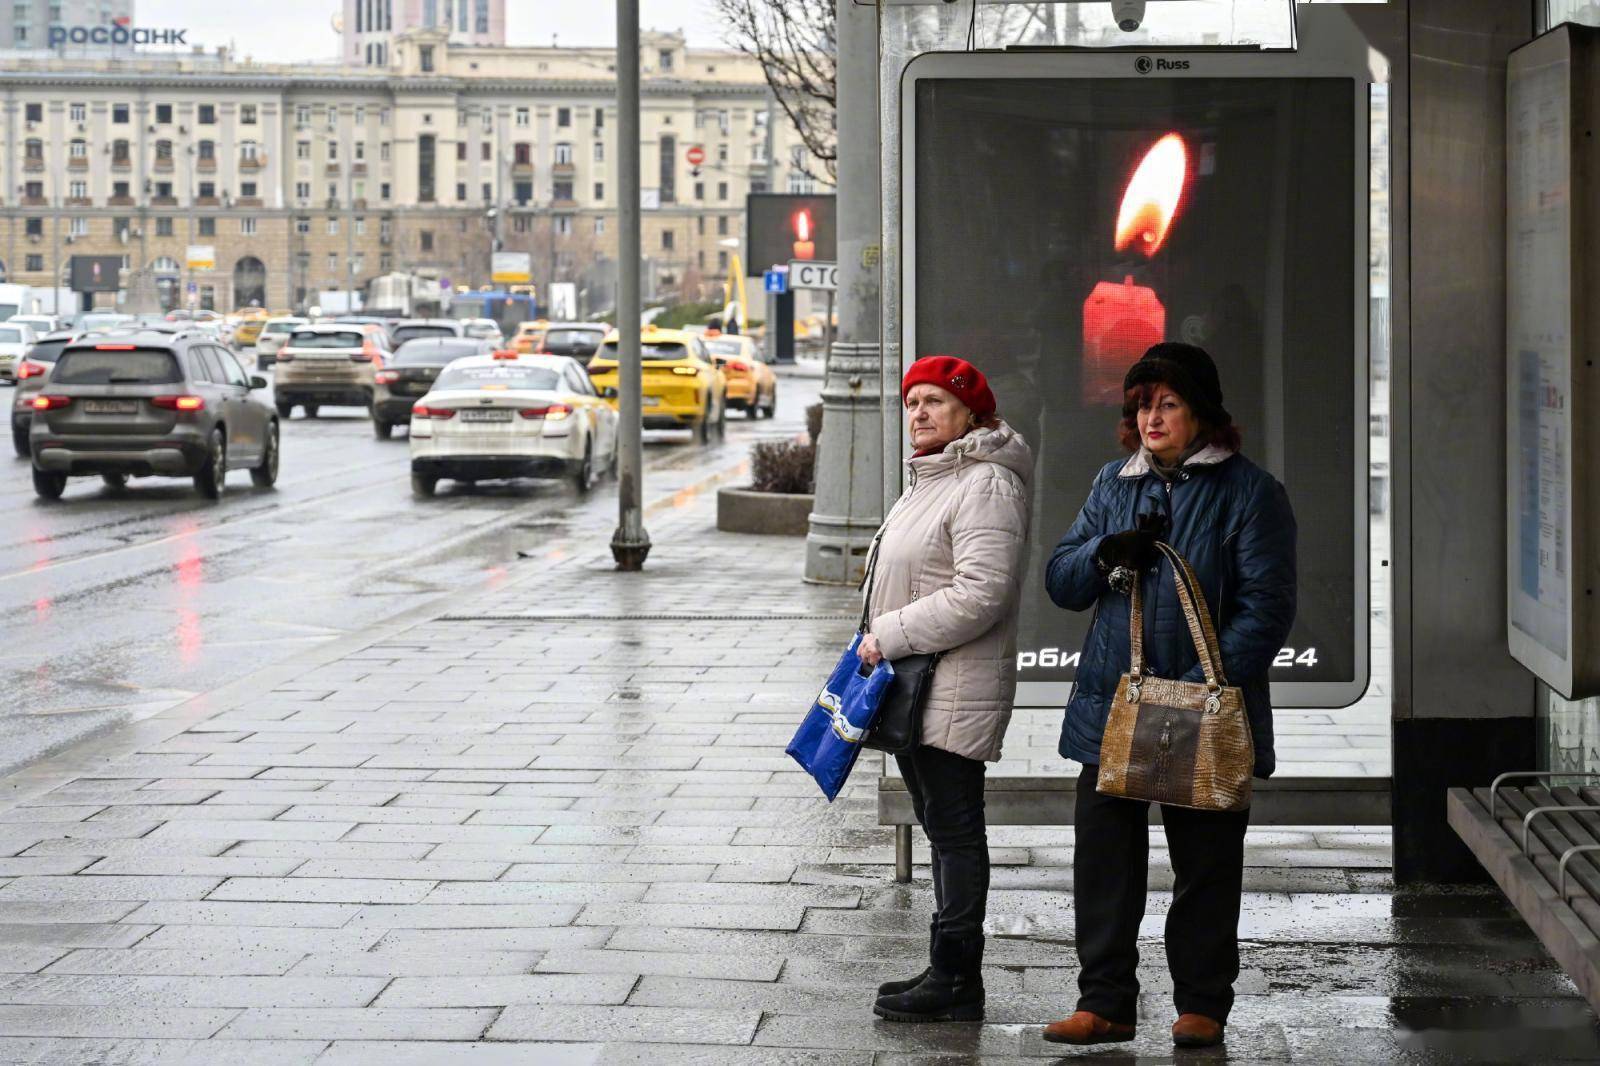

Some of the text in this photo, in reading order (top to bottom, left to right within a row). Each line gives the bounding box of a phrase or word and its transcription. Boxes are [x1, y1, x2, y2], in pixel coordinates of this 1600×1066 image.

[48, 18, 187, 49] росбанк
[1156, 58, 1190, 70] Russ
[1272, 647, 1318, 667] 24
